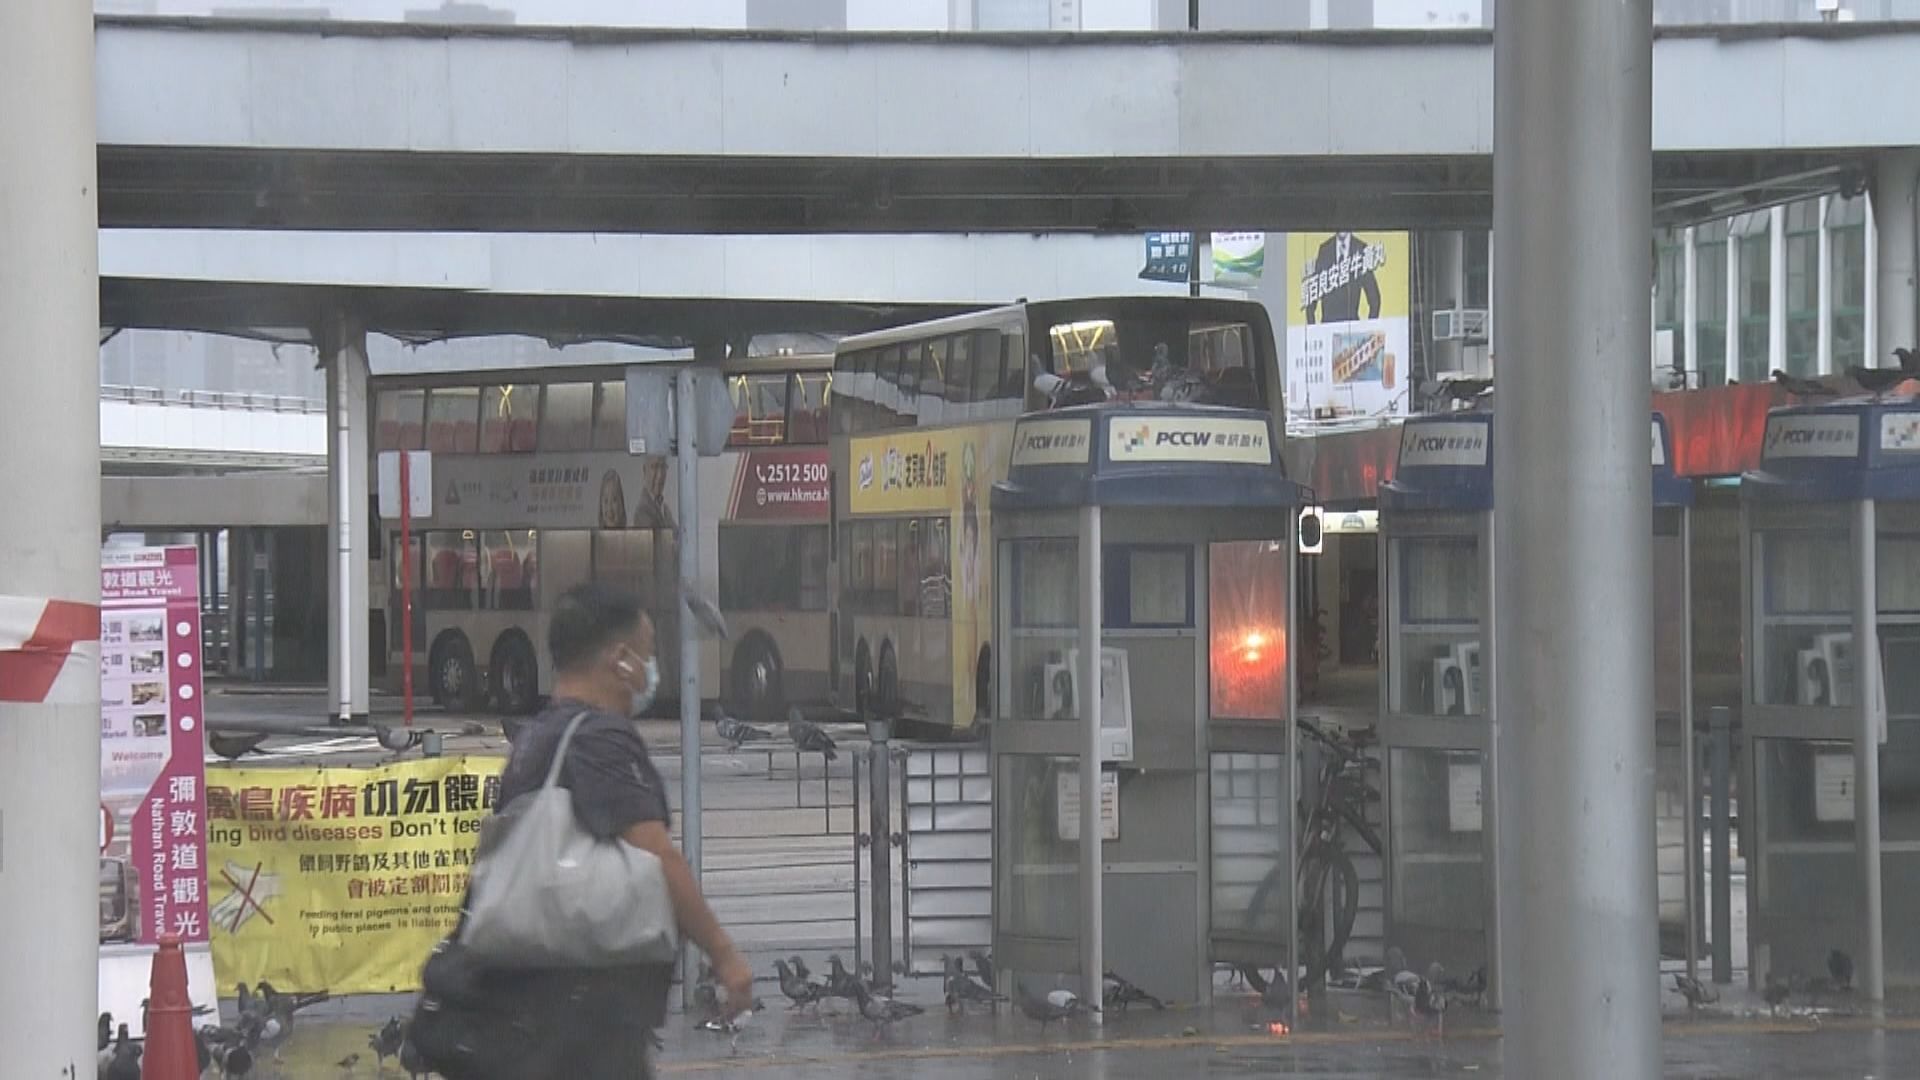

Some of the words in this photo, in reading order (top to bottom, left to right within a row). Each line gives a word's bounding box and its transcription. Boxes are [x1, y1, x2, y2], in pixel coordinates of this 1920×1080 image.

[1156, 431, 1211, 446] PCCW
[767, 463, 800, 482] 2512
[112, 751, 163, 762] Welcome
[151, 797, 165, 850] Nathan
[207, 823, 241, 847] ing
[248, 825, 286, 841] bird
[293, 824, 383, 842] diseases
[390, 818, 447, 838] Don't
[453, 817, 481, 834] fee
[169, 776, 200, 936] 彌敦道觀光
[153, 853, 166, 891] Road
[154, 894, 168, 939] Trave
[412, 906, 431, 914] and
